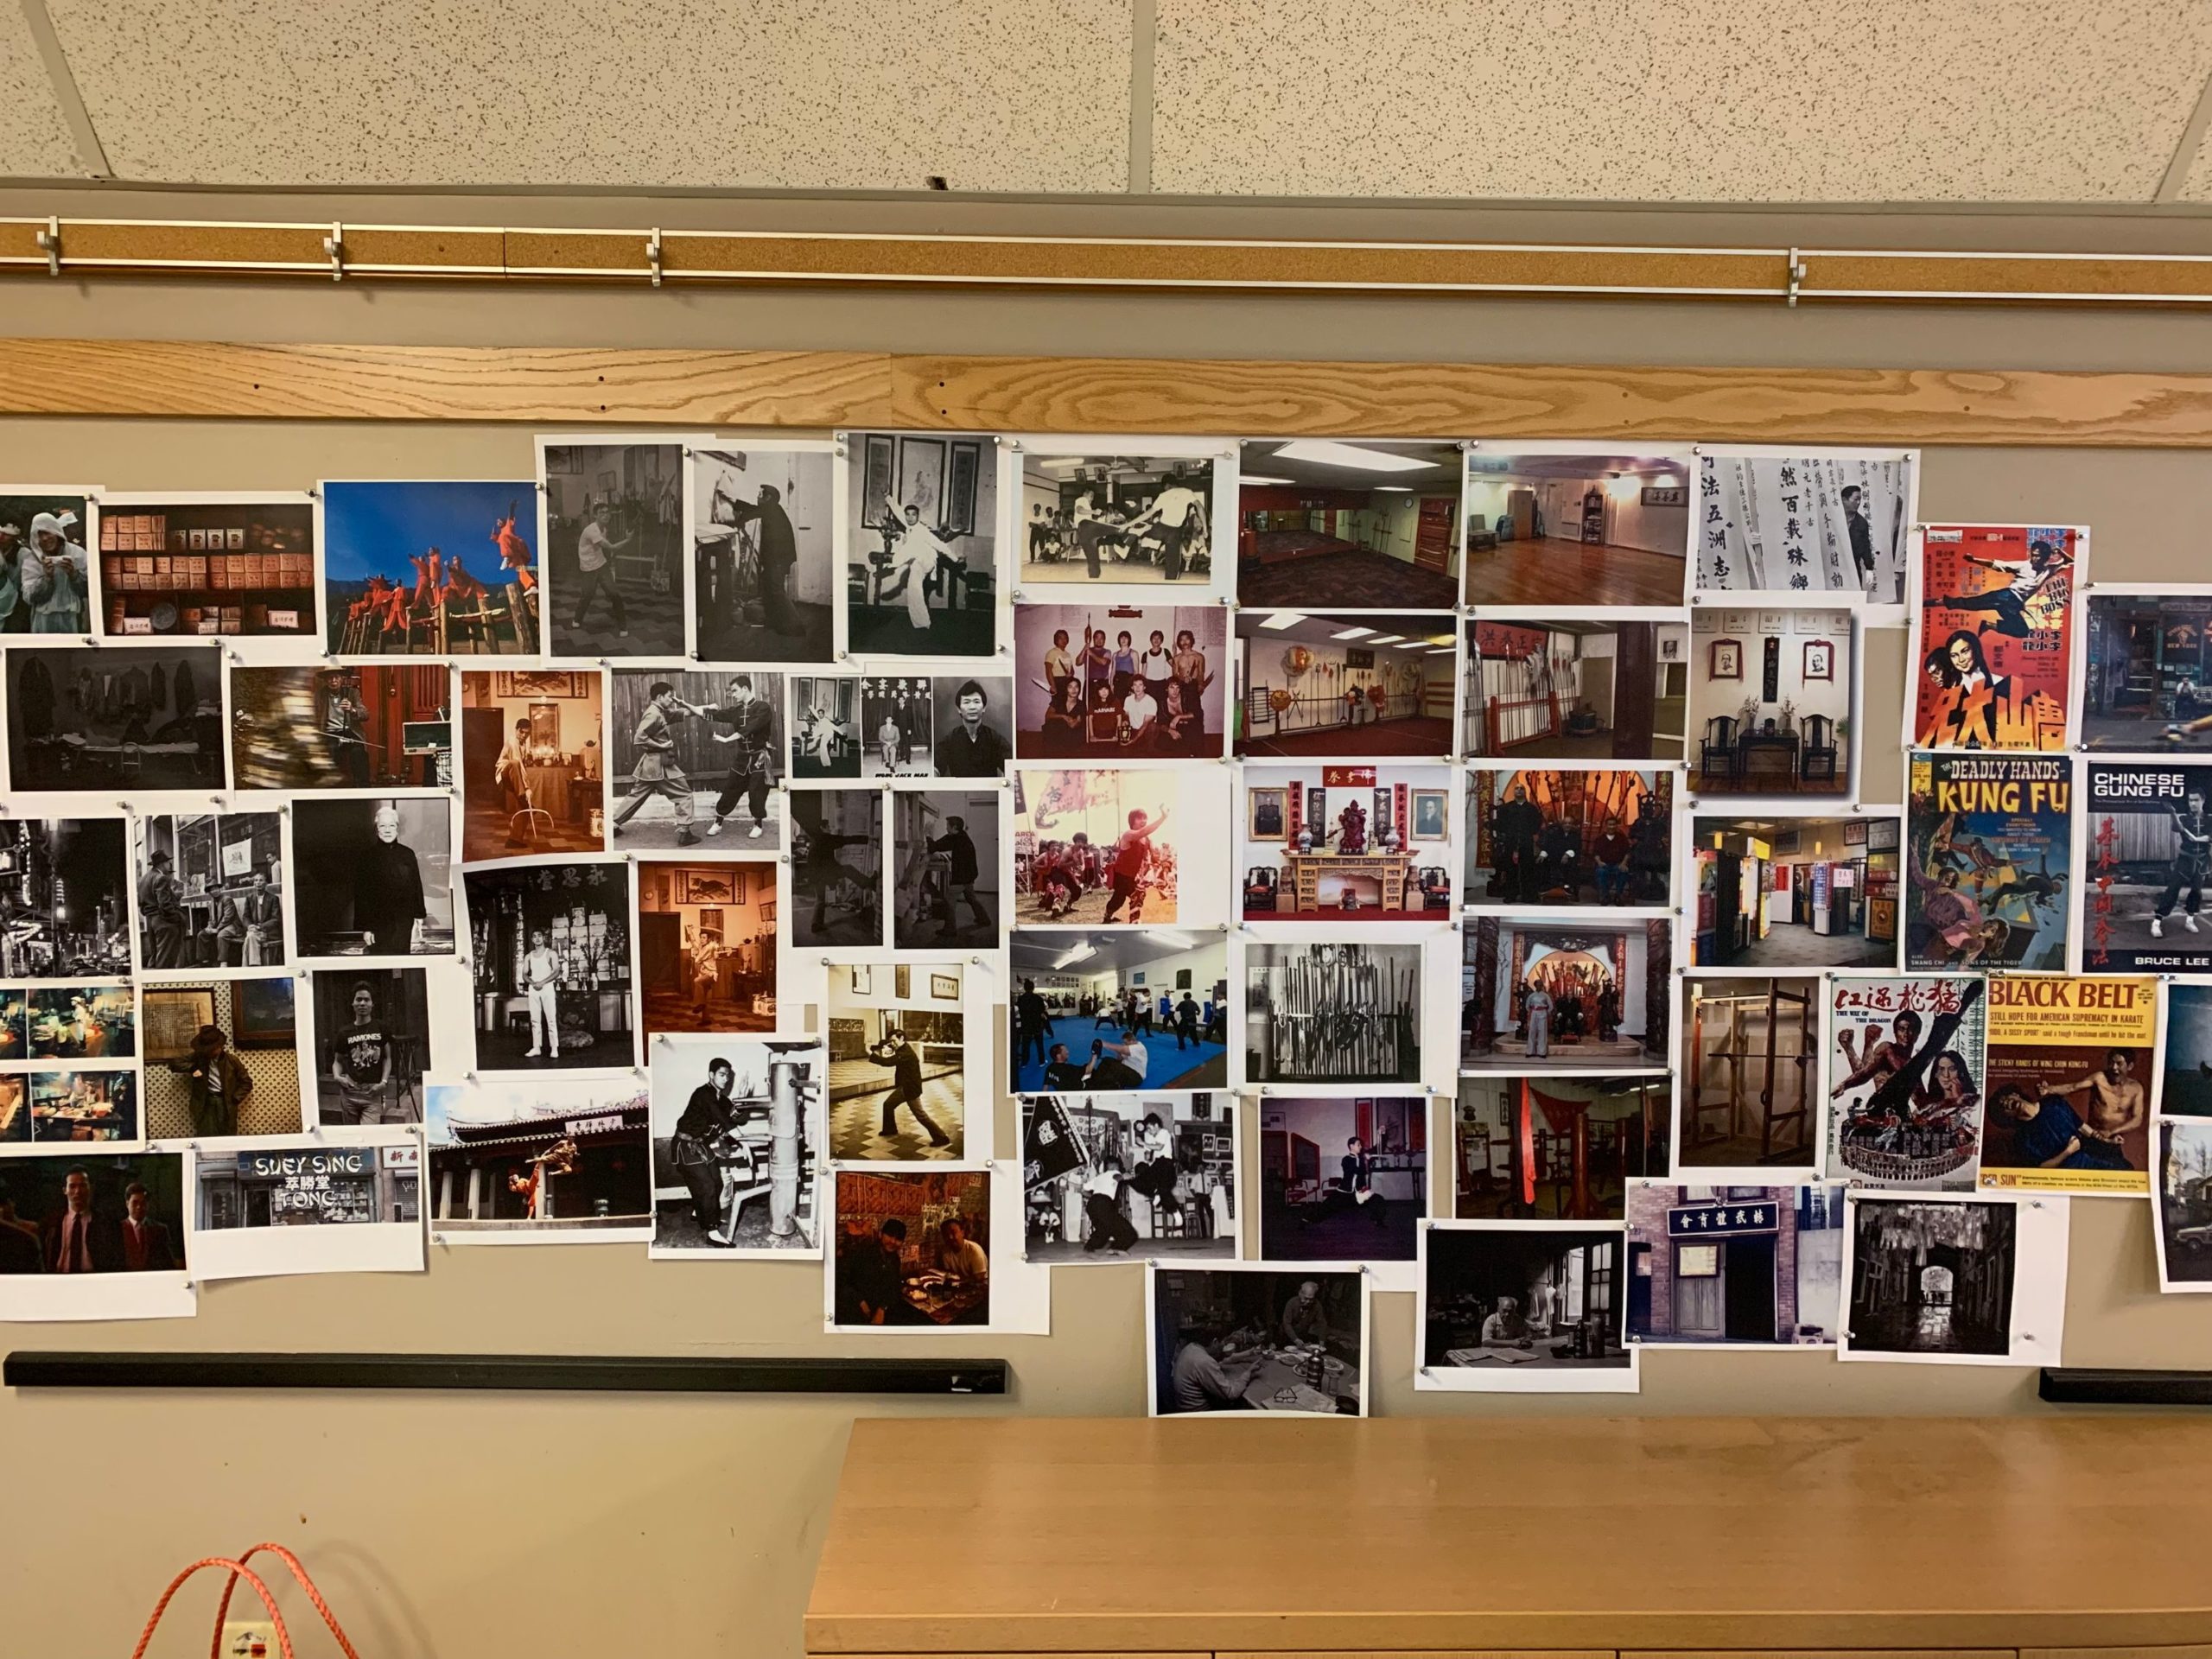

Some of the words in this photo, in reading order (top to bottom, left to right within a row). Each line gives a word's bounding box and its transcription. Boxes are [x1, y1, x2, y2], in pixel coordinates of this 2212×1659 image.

[2040, 598, 2071, 615] BOSS
[1950, 760, 2007, 780] DEADLY
[2010, 761, 2061, 781] HANDS
[2094, 772, 2185, 786] CHINESE
[1938, 781, 2021, 813] KUNG
[2030, 782, 2070, 814] FU
[2094, 785, 2152, 797] GUNG
[2158, 785, 2184, 798] FU
[2135, 957, 2181, 965] BRUCE
[2185, 957, 2210, 966] LEE
[1988, 981, 2070, 1007] BLACK
[2078, 983, 2139, 1009] BELT
[1990, 1012, 2005, 1020] STILL
[2040, 1013, 2070, 1021] AMERICAN
[2072, 1014, 2108, 1022] SUPREMACY
[2120, 1014, 2144, 1024] KARATE
[347, 1033, 382, 1044] RAMONES
[255, 1156, 307, 1176] SUEY
[312, 1154, 363, 1174] SING
[279, 1190, 337, 1208] TONG
